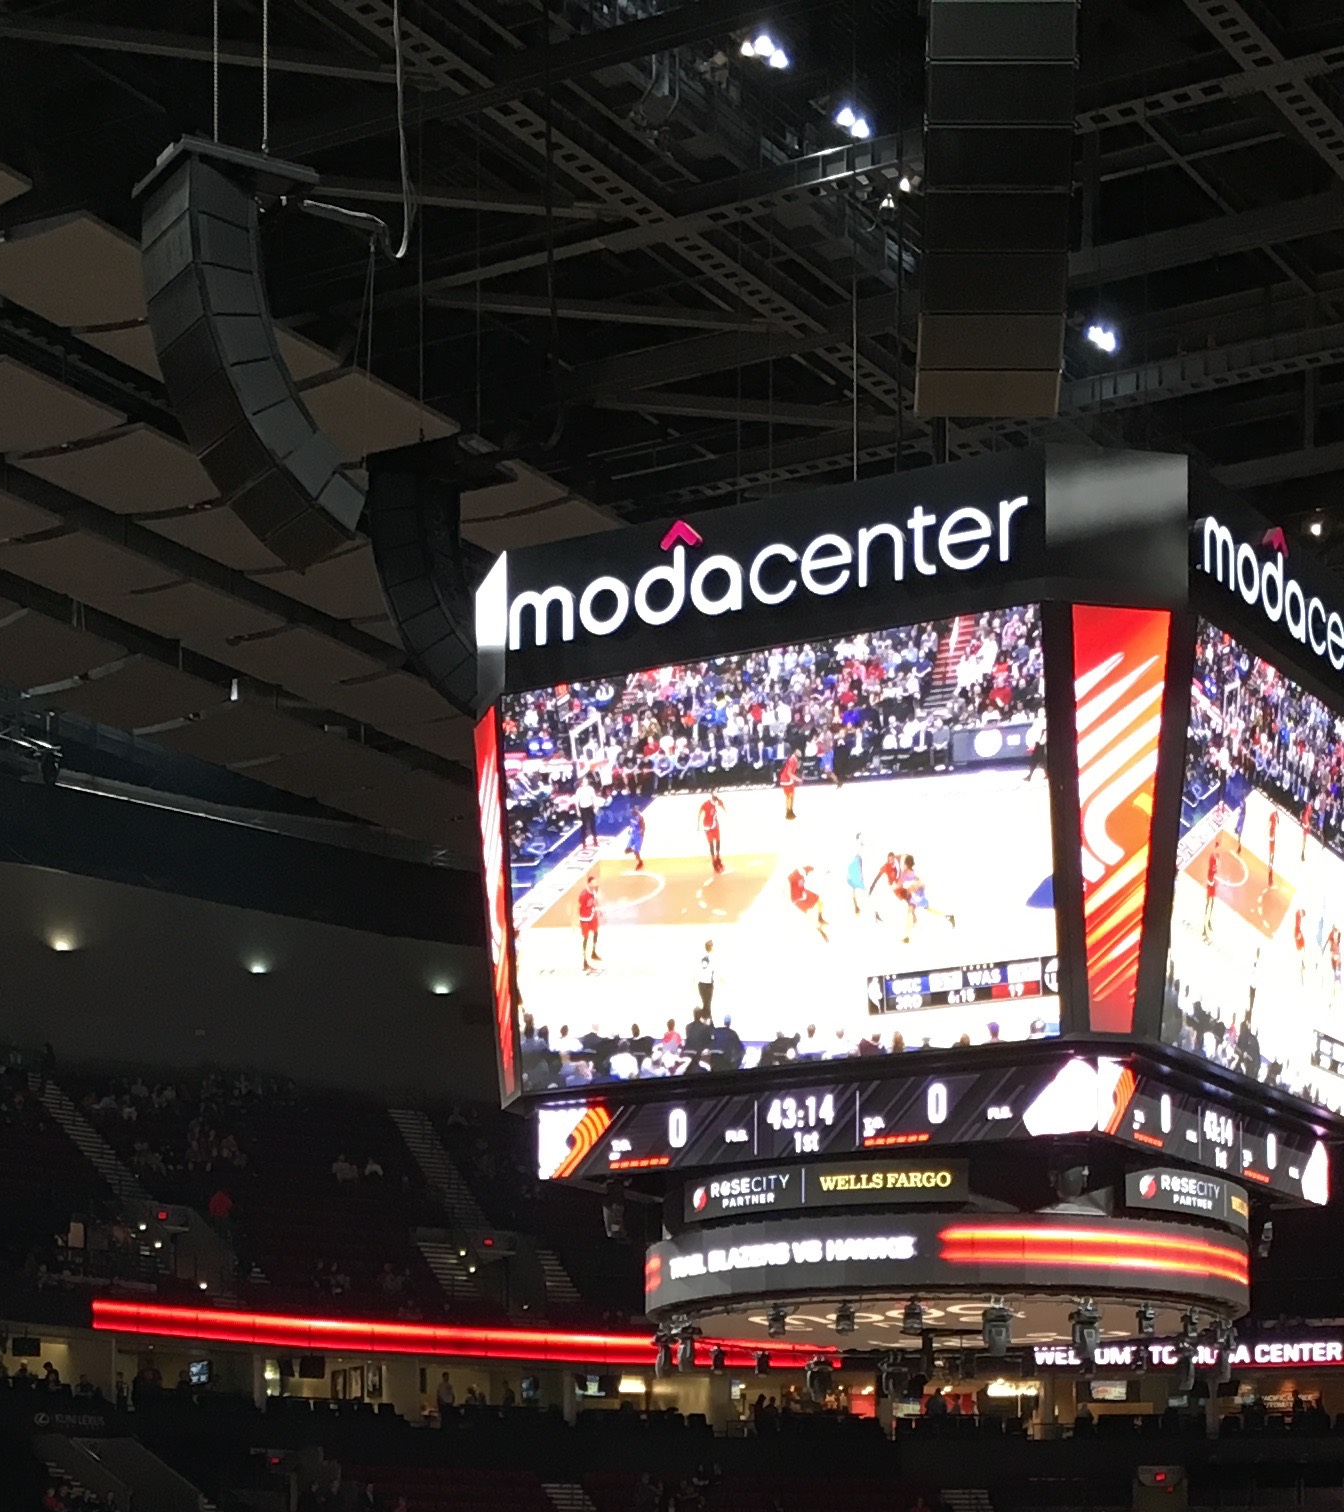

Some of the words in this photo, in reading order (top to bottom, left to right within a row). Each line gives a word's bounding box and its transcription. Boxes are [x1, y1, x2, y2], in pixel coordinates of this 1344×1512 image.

[766, 1094, 835, 1131] 43:14
[927, 1082, 948, 1124] 0
[668, 1108, 688, 1149] 0
[793, 1130, 819, 1154] 1st
[819, 1172, 883, 1191] WELLS
[886, 1170, 953, 1189] FARGO
[721, 1191, 775, 1210] PARTNER
[1172, 1193, 1213, 1211] PARTNER
[1254, 1341, 1344, 1364] CENTER
